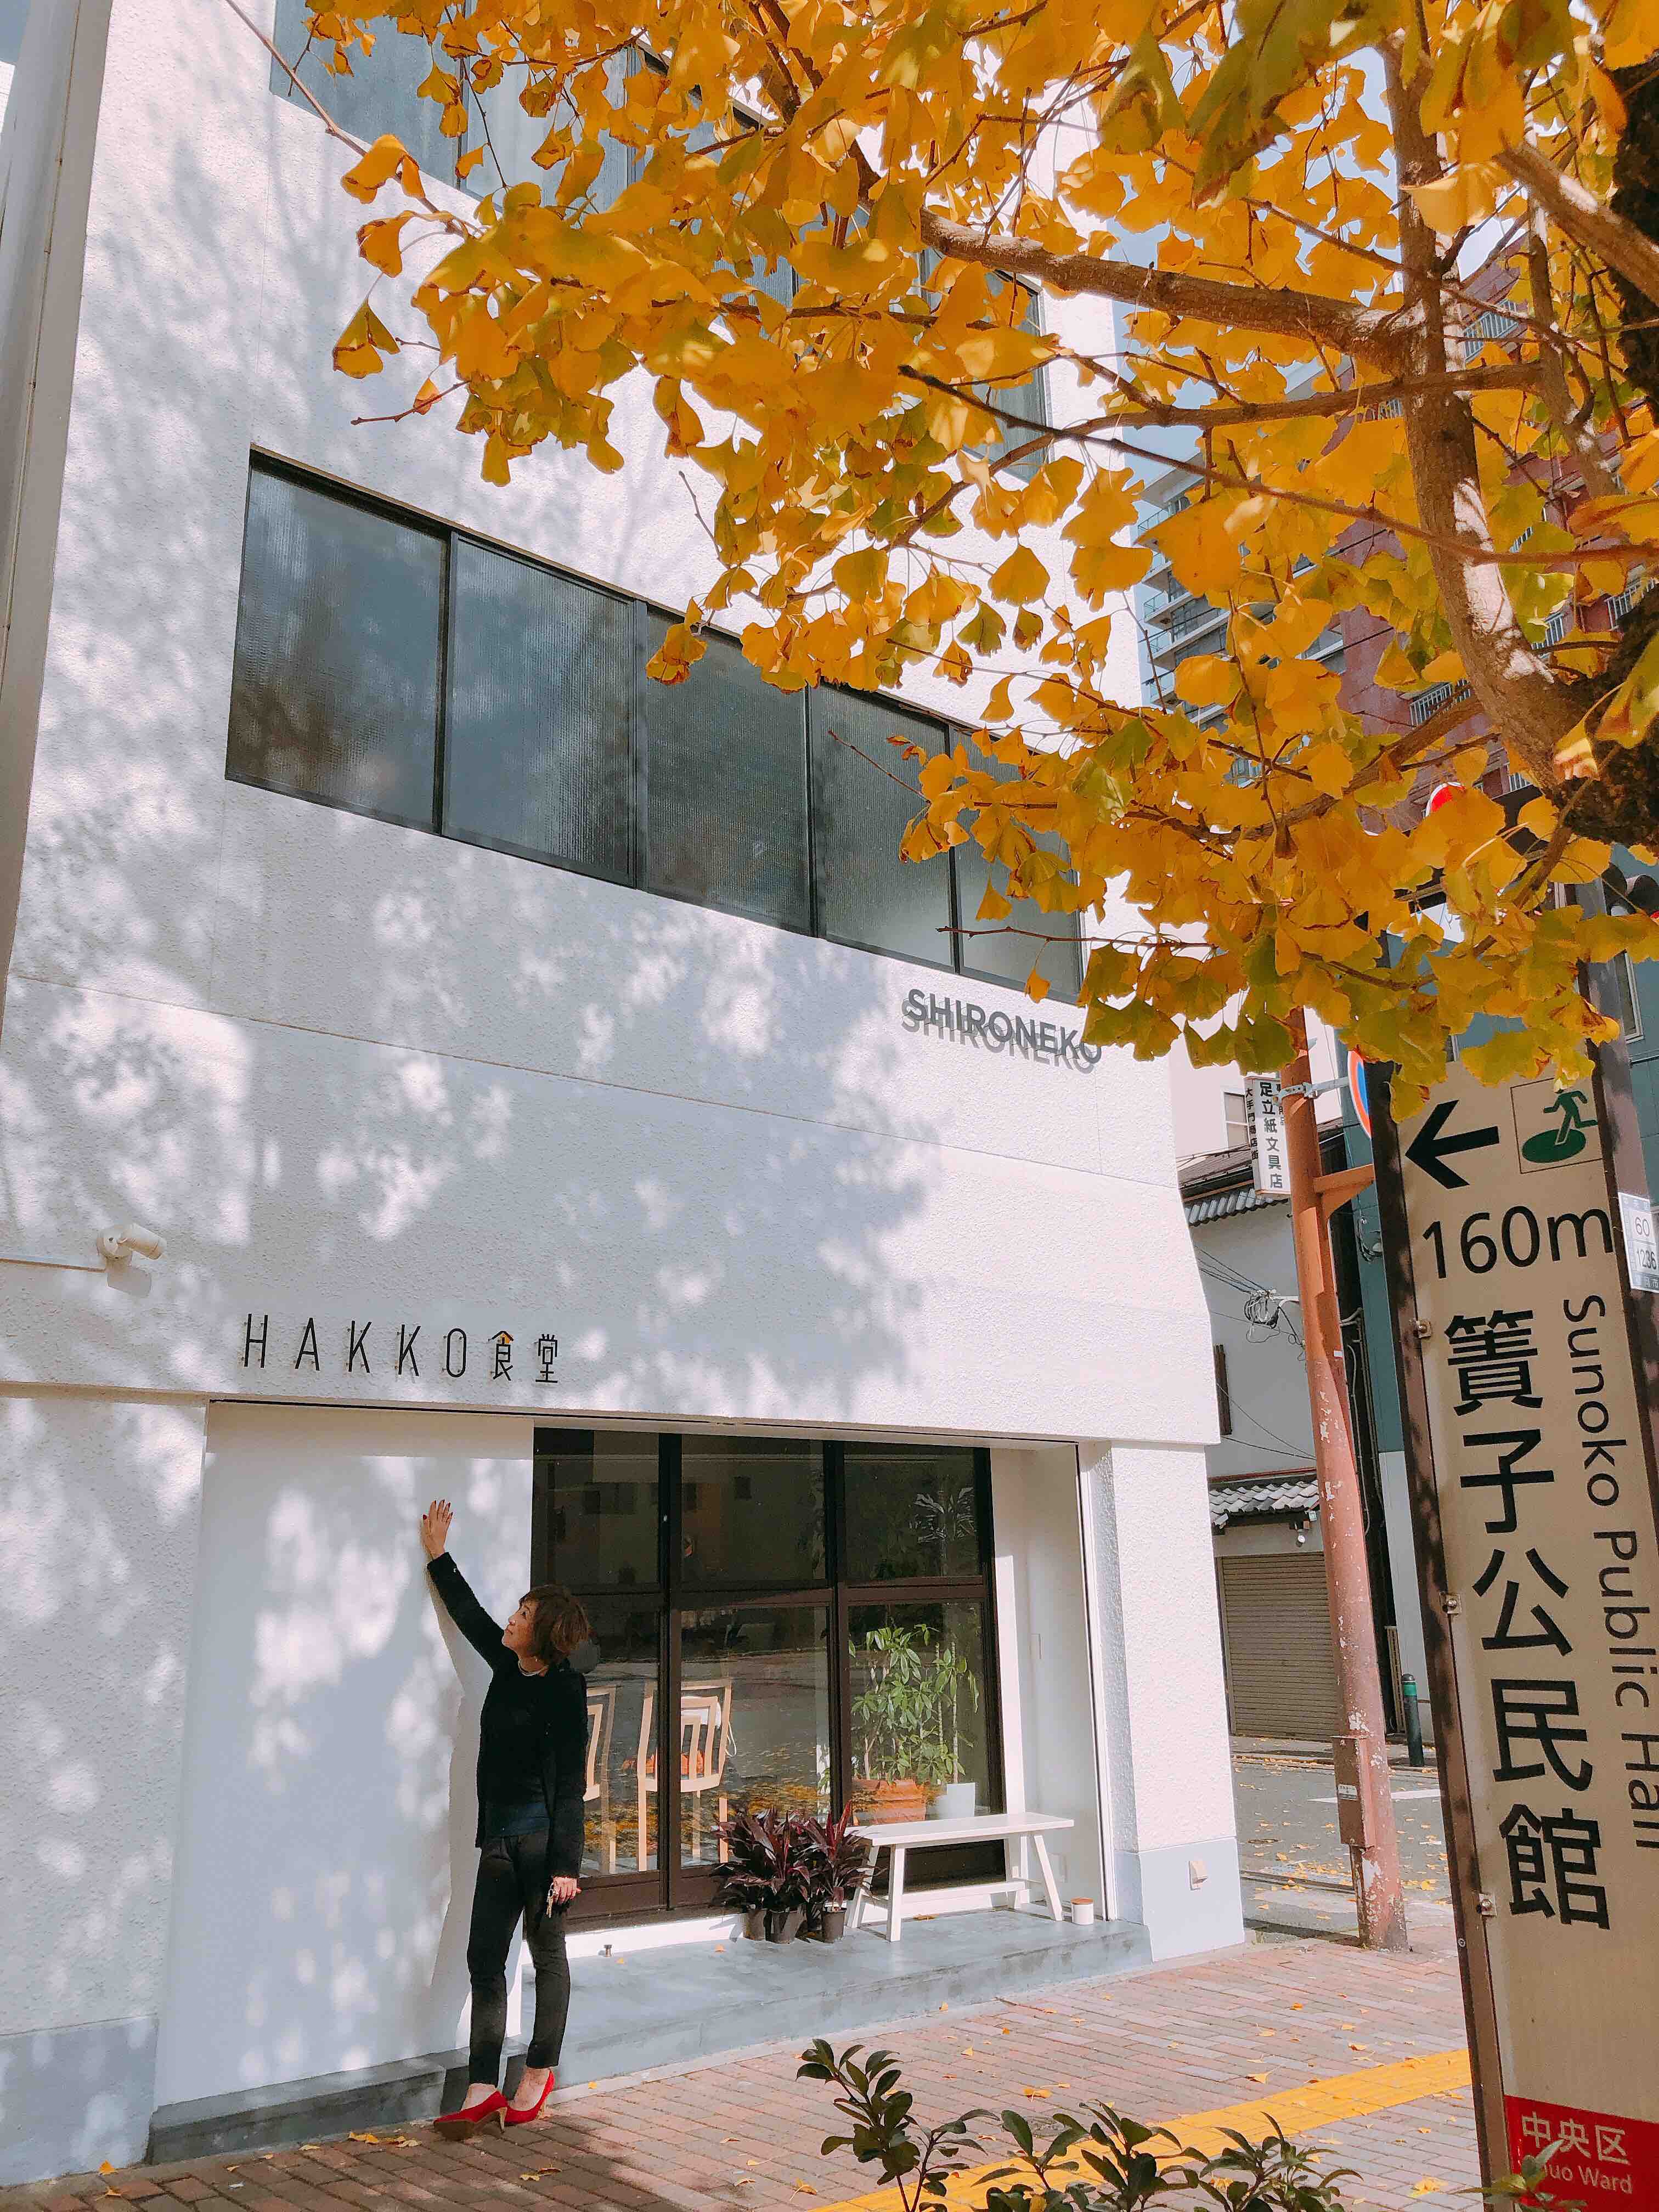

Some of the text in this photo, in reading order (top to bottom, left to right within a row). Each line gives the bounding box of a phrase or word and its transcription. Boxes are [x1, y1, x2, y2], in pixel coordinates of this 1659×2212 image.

[906, 989, 1102, 1064] SHIRONEKO
[1260, 1081, 1283, 1189] 足立紙文具店
[1422, 1205, 1614, 1279] 160m
[1563, 1295, 1627, 1506] Sunoko
[1444, 1310, 1611, 1931] 簀子公民館
[1593, 1531, 1658, 1707] Public
[1522, 2111, 1631, 2166] 中央区
[1578, 2165, 1633, 2194] Ward
